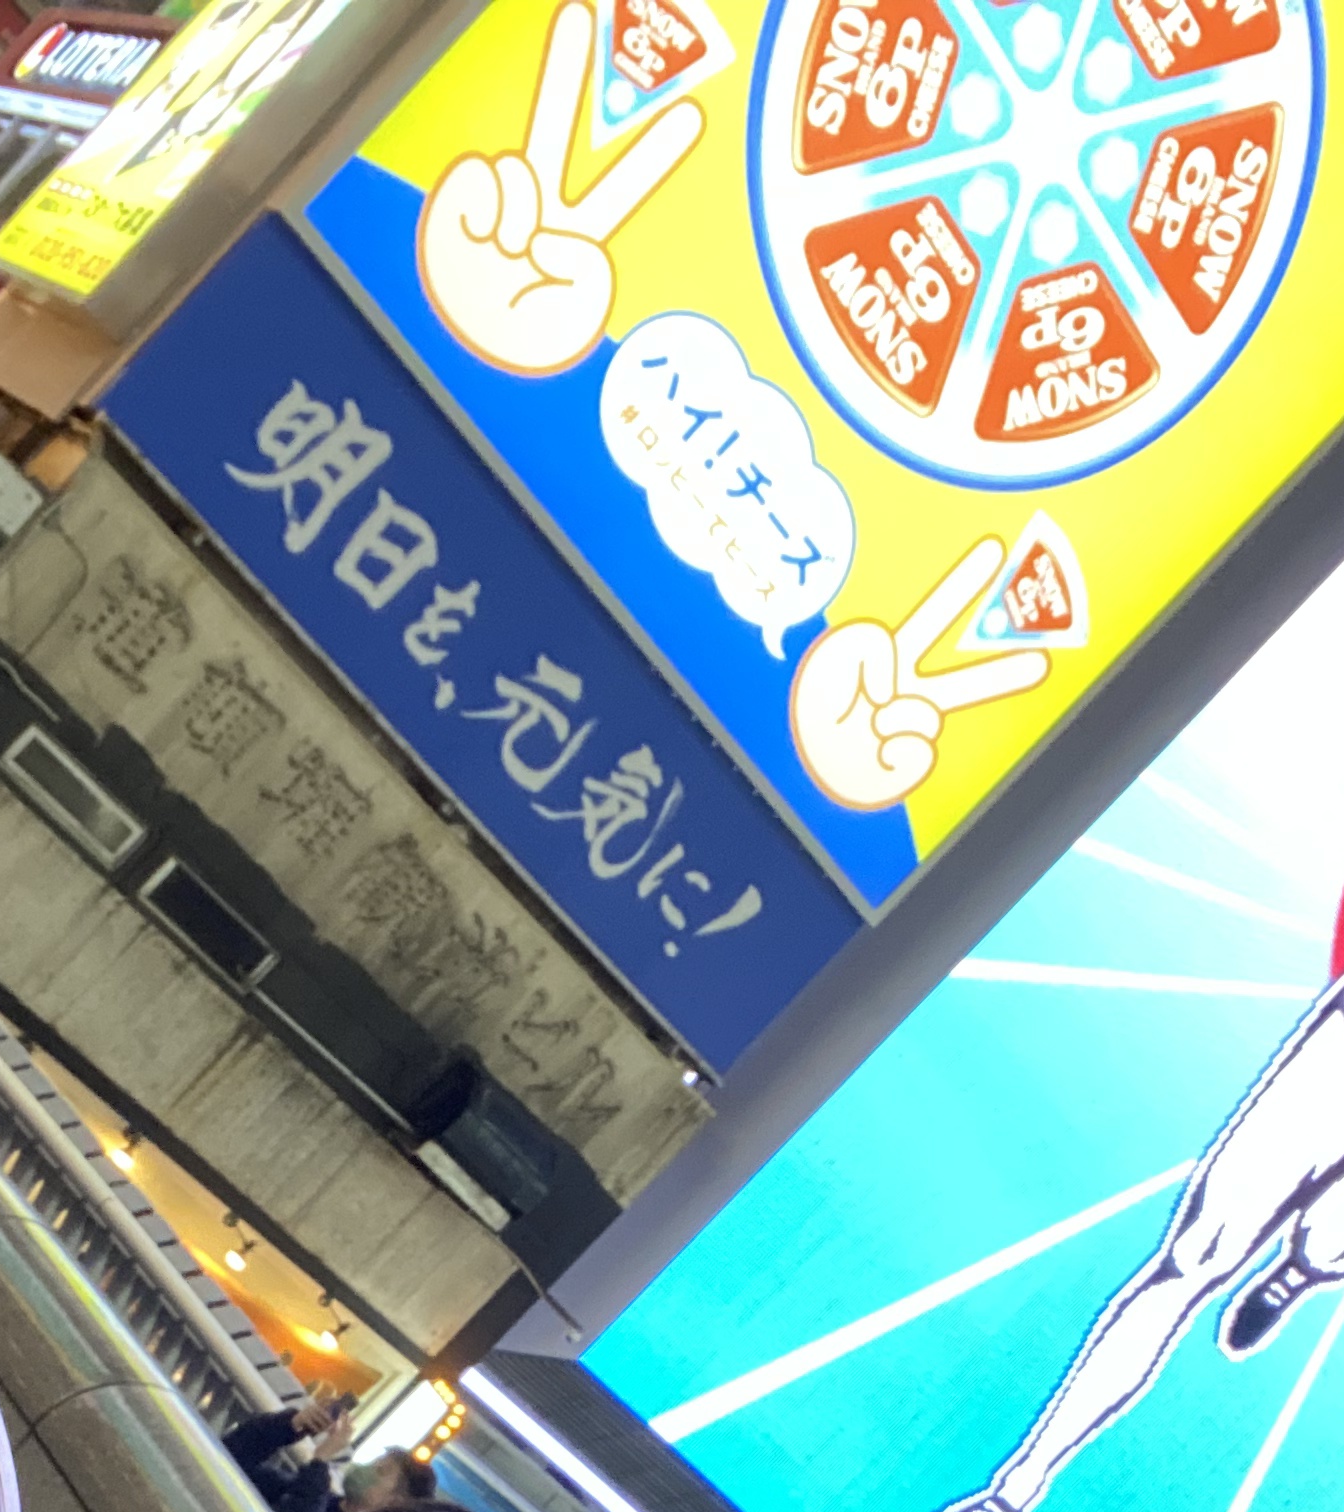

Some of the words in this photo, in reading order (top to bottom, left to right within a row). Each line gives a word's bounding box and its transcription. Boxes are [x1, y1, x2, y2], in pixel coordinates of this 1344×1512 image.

[866, 17, 930, 129] 6P
[908, 35, 954, 138] CHEESE
[1132, 137, 1180, 234] CHEESE
[1161, 146, 1216, 250] 6P
[1193, 139, 1268, 304] SNOW
[890, 229, 951, 322] 6P
[916, 202, 975, 285] CHEESE
[1021, 269, 1099, 310] CHEESE
[821, 252, 928, 384] SNOW
[1021, 306, 1106, 351] 6P
[1004, 357, 1127, 430] SNOW
